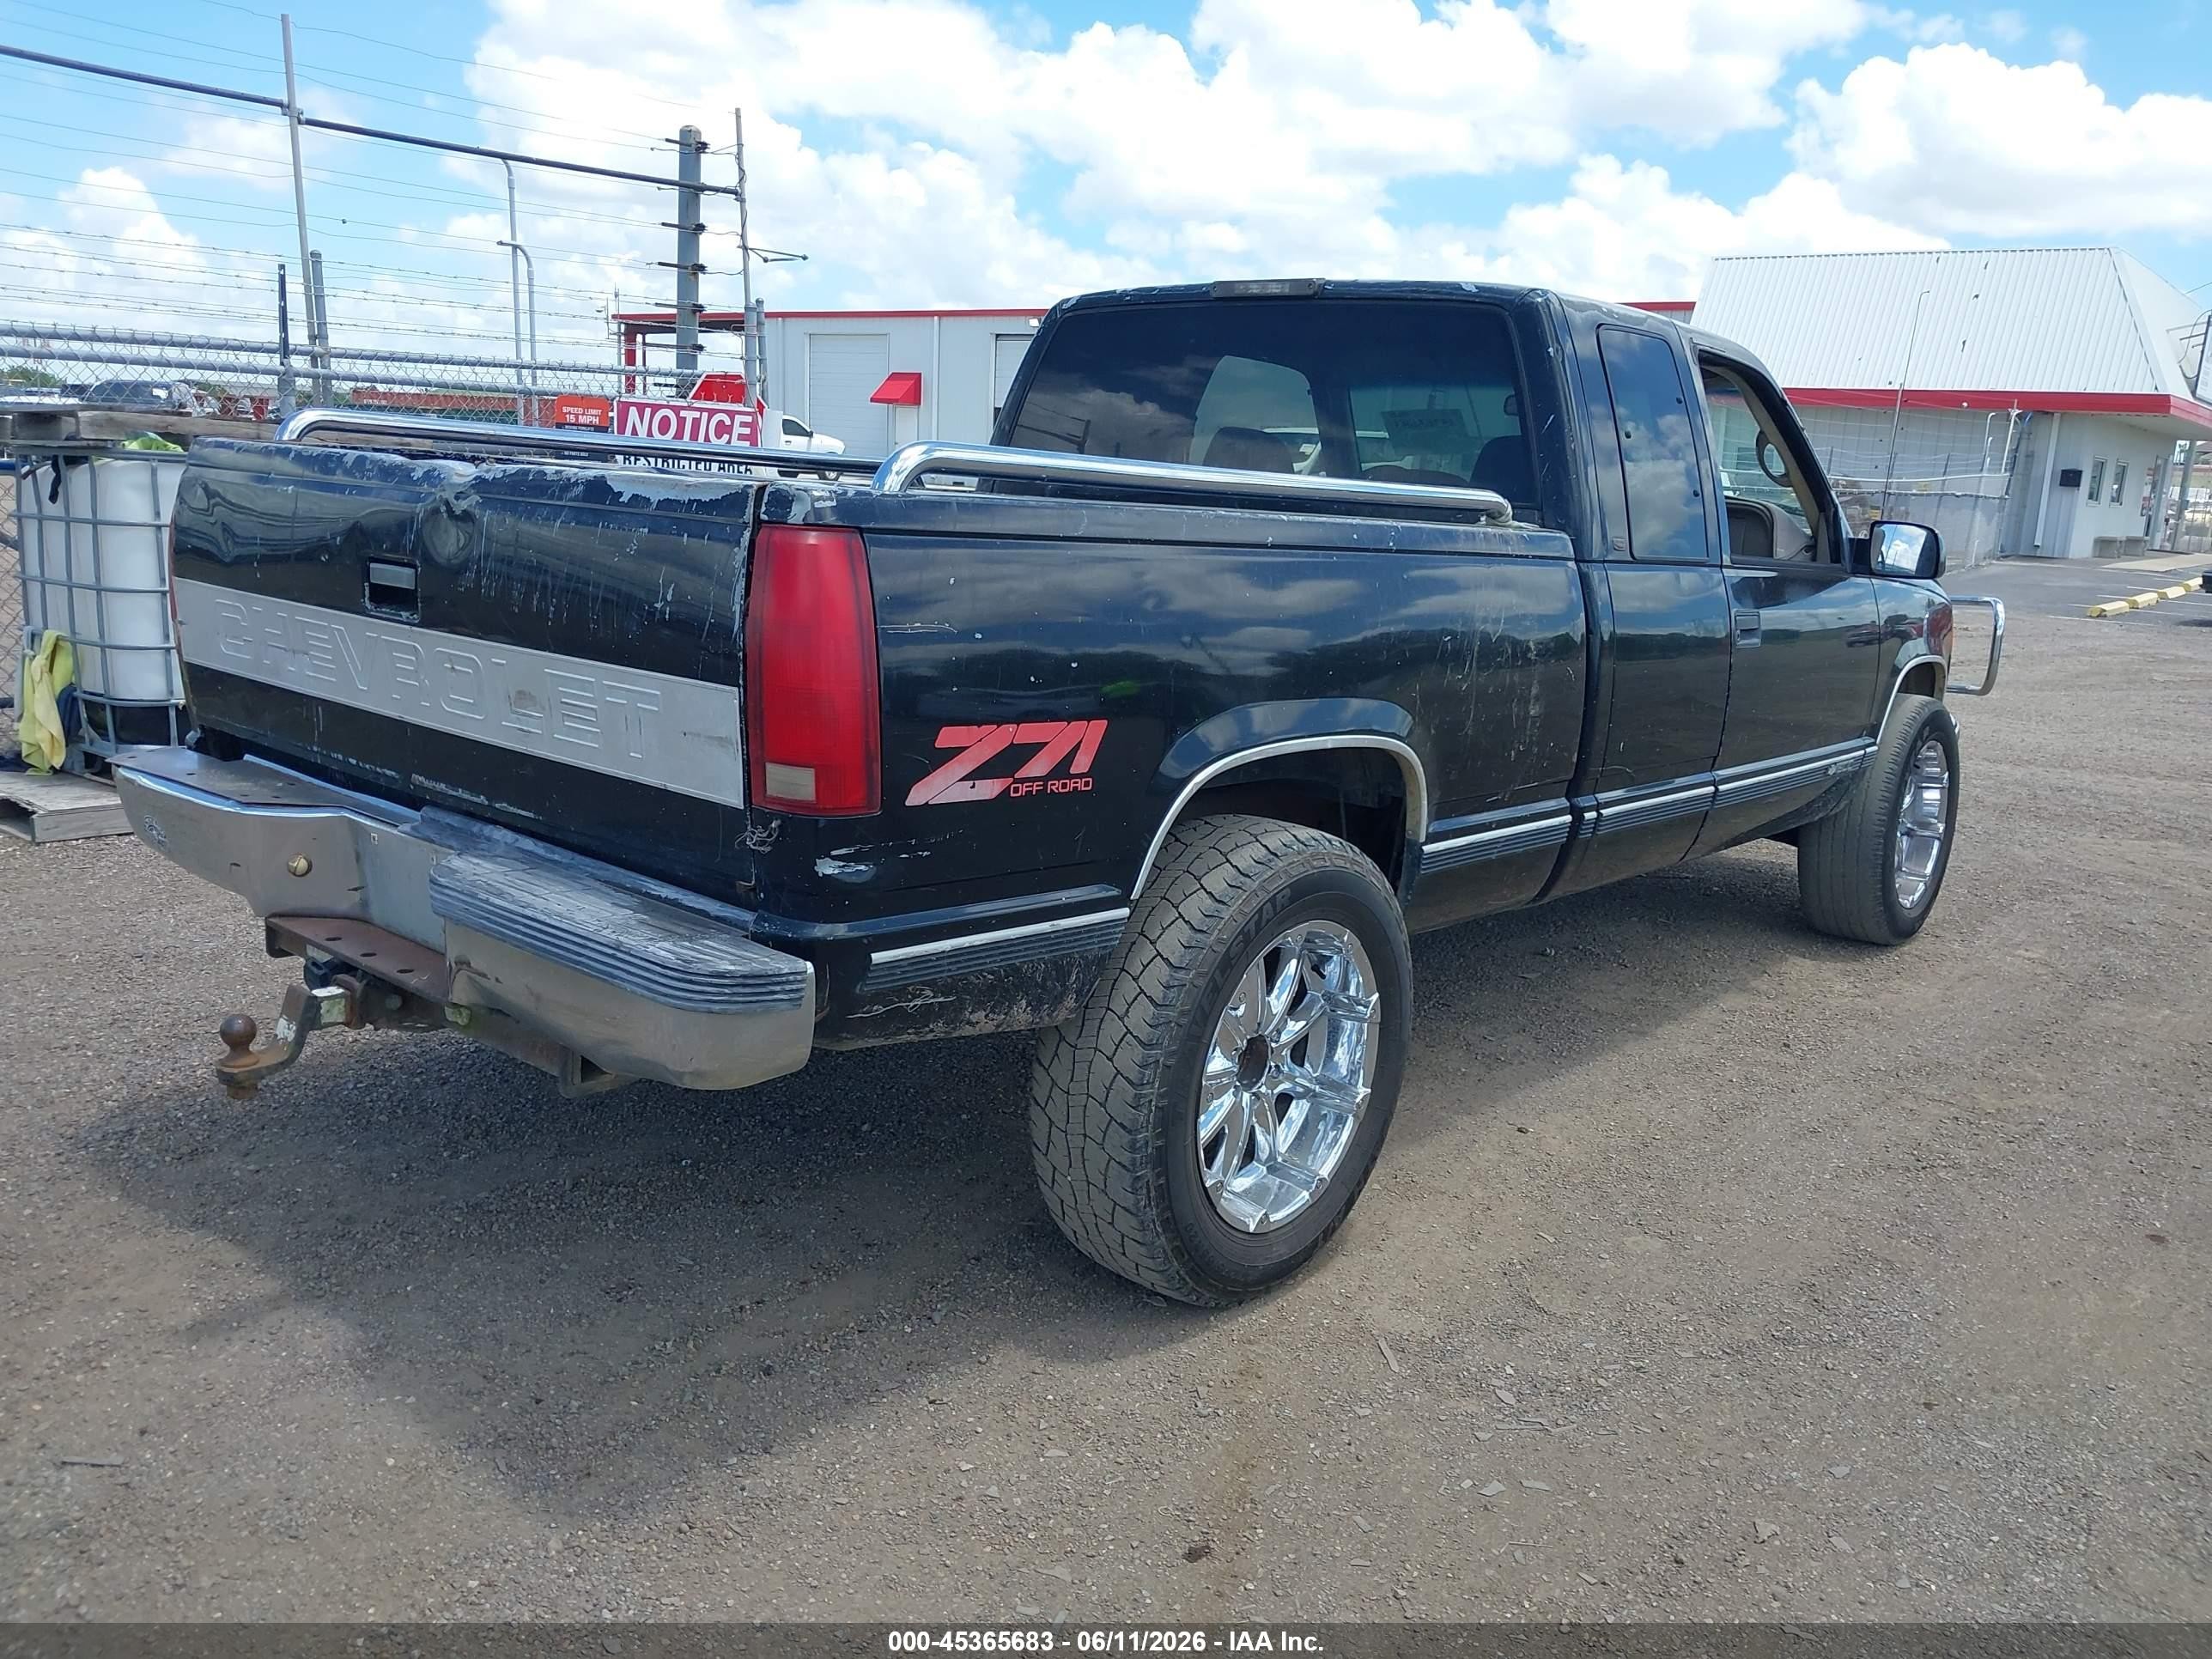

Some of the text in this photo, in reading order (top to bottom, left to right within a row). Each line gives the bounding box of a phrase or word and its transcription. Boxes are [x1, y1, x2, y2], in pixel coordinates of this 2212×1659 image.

[565, 414, 599, 425] 15 MPH
[624, 405, 752, 447] NOTICE
[216, 599, 660, 758] CHEVROLET
[904, 719, 1108, 806] Z71
[1009, 777, 1092, 797] OFF ROAD
